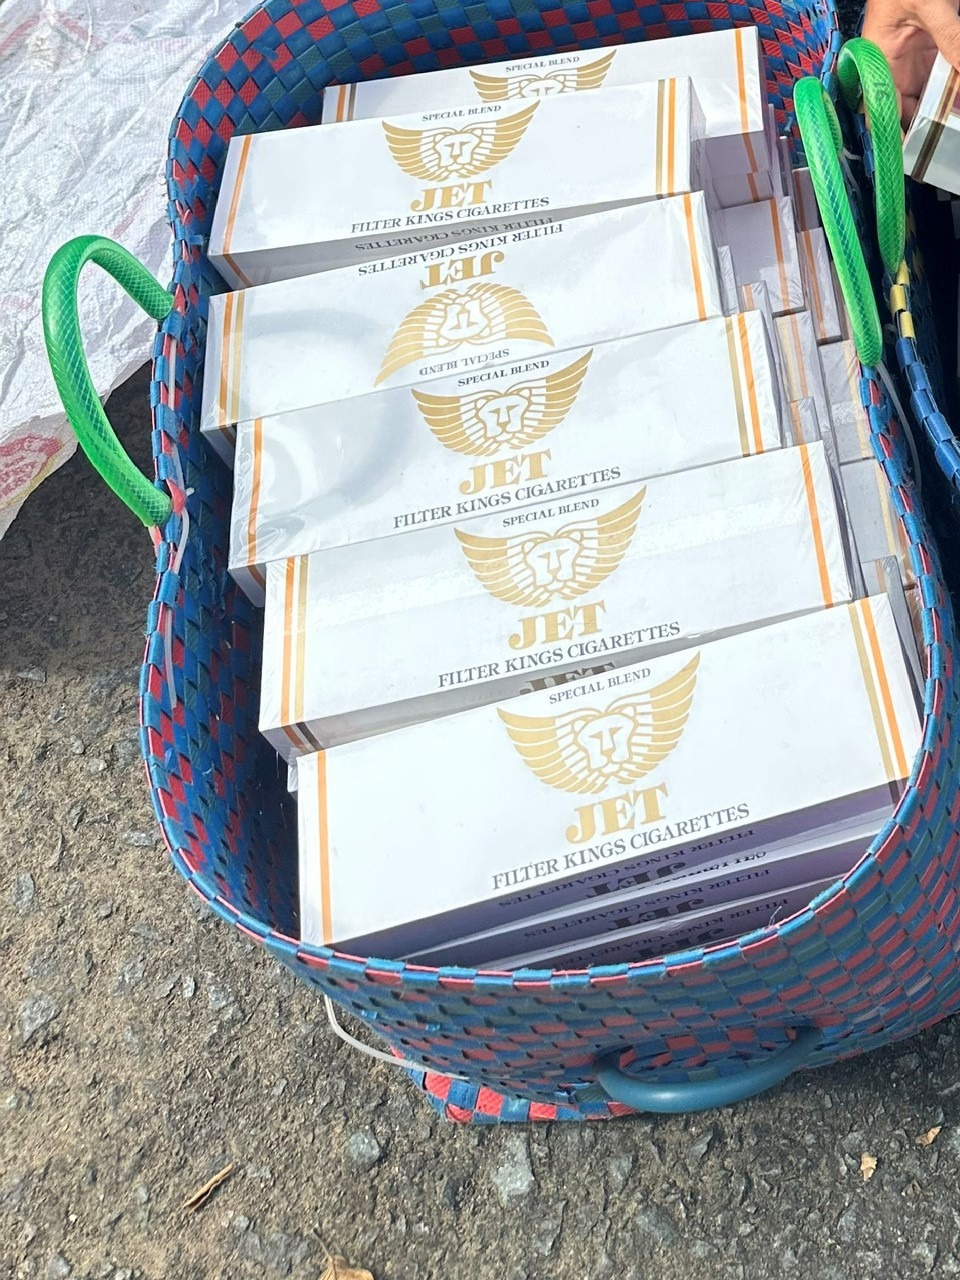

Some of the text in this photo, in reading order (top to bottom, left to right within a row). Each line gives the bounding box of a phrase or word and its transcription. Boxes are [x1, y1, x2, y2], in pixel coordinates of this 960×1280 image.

[506, 56, 580, 72] SPECIAL BLEND
[422, 105, 501, 122] SPECIAL BLEND
[410, 180, 492, 212] JET
[351, 197, 549, 233] FILTER KINGS CIGARETTES
[451, 224, 499, 236] KINGS
[355, 232, 449, 251] CIGARETTES
[358, 224, 563, 276] FILTER KINGS CIGARETTES
[420, 251, 505, 290] JET
[419, 348, 510, 376] SPECIAL BLEND
[458, 360, 550, 387] SPECIAL BLEND
[459, 449, 551, 495] JET
[393, 467, 621, 528] FILTER KINGS CIGARETTES
[503, 498, 600, 527] SPECIAL BLEND
[508, 600, 606, 650] JET
[438, 621, 681, 688] FILTER KINGS CIGARETTES
[549, 668, 651, 704] SPECIAL BLEND
[565, 782, 668, 844] JET
[492, 859, 559, 890] FILTER
[562, 838, 626, 869] KINGS
[630, 803, 750, 850] CIGARETTES
[691, 830, 755, 852] FILTER
[624, 849, 685, 871] KINGS
[499, 870, 615, 907] CIGARETTES
[709, 869, 770, 890] FILTER
[644, 887, 703, 907] KINGS
[524, 904, 640, 938] CIGARETTES
